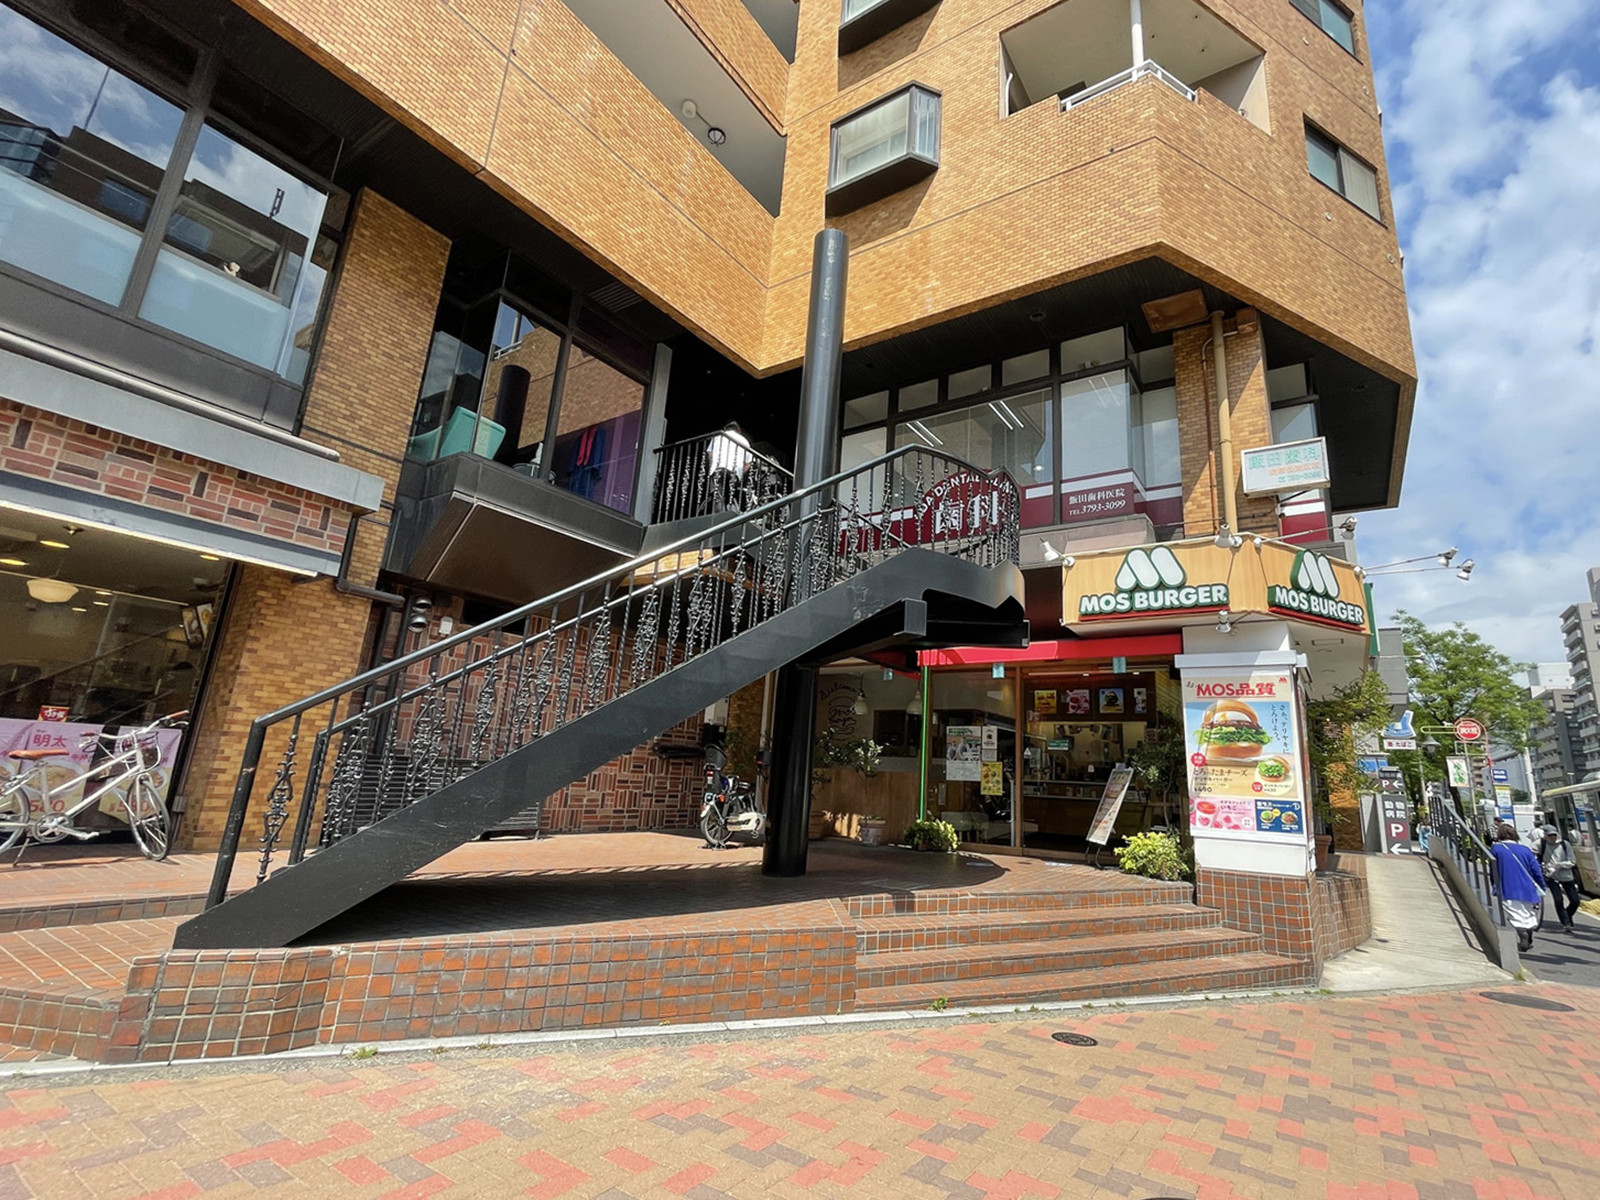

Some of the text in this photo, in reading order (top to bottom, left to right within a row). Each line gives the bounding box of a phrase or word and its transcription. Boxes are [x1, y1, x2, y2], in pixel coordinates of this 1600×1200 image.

[1081, 500, 1126, 514] 3793-3099
[1080, 585, 1228, 613] MOS BURGER
[1275, 586, 1364, 623] MOS BURGER
[1196, 682, 1276, 696] MOS品質
[33, 734, 67, 747] 明太
[1382, 780, 1389, 788] P
[1384, 801, 1405, 809] 動物
[1385, 810, 1406, 819] 病院
[1391, 823, 1404, 837] P
